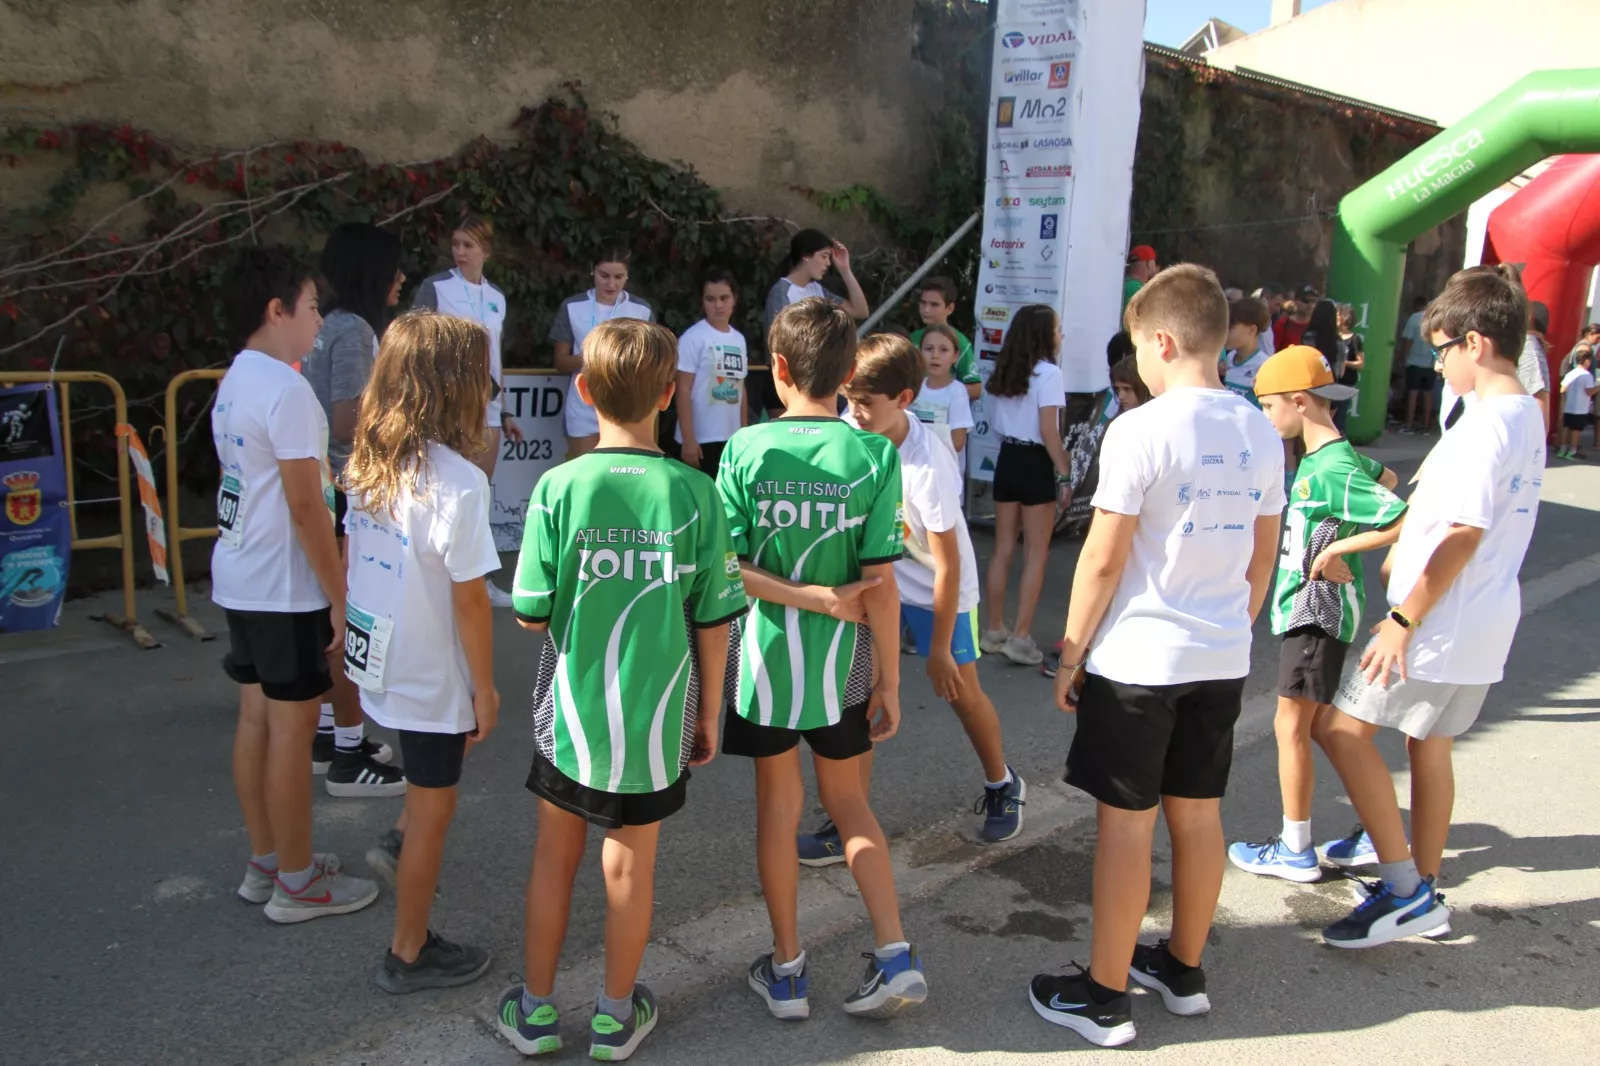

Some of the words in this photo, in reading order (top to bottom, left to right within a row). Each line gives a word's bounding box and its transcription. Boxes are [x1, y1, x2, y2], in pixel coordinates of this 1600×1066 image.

[1028, 30, 1076, 47] VIDAL
[1029, 196, 1066, 208] seytam
[725, 356, 741, 368] 481
[789, 426, 822, 435] VIATOR
[502, 439, 553, 461] 2023
[609, 466, 647, 475] VIATOR
[756, 480, 851, 499] ATLETISMO
[756, 499, 846, 533] ZOITI
[575, 528, 675, 547] ATLETISMO
